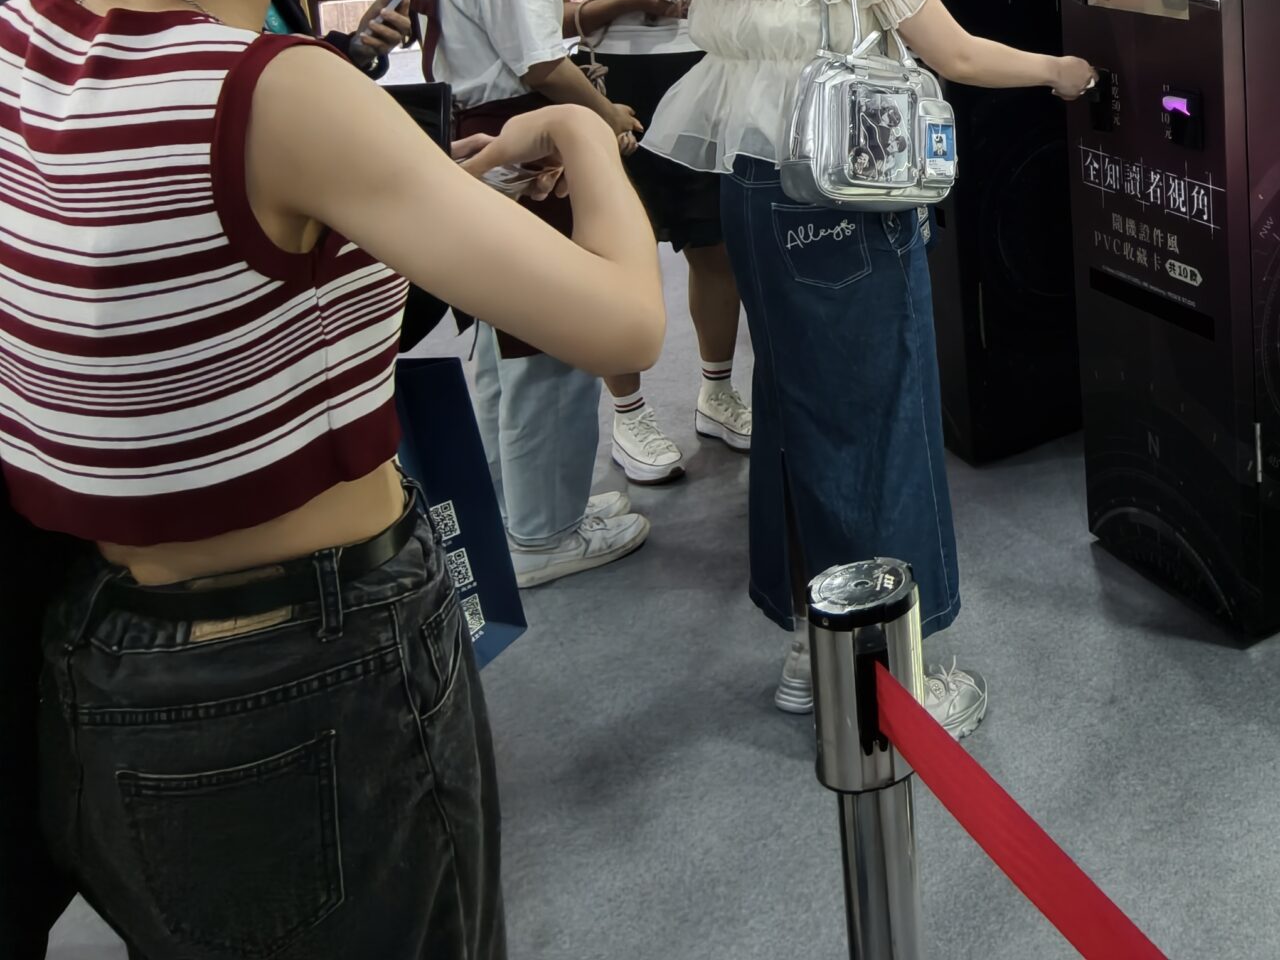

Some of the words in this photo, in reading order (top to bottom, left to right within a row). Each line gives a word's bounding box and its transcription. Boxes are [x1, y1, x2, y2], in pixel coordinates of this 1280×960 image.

[1085, 152, 1209, 221] 全知讀者視角
